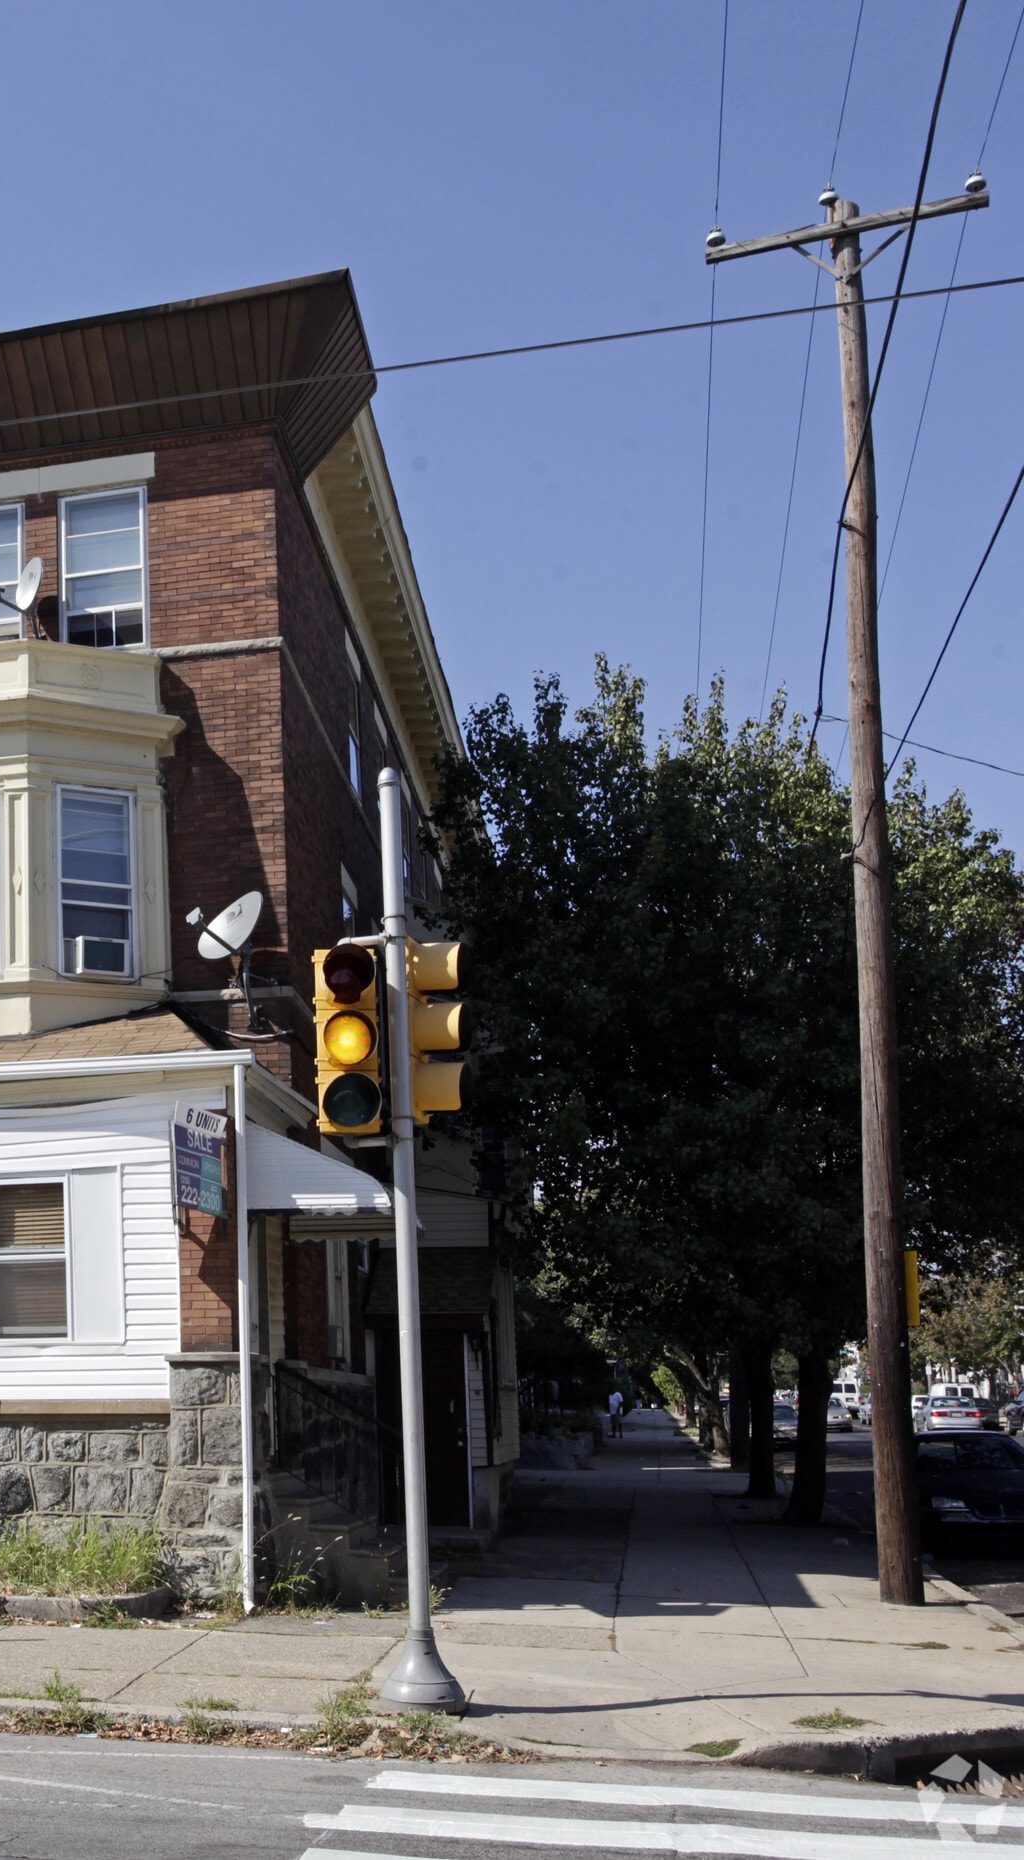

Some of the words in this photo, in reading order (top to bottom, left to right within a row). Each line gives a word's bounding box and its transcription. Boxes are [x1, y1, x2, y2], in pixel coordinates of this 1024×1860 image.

[186, 1108, 193, 1123] 6
[195, 1111, 220, 1133] UNITS
[187, 1129, 213, 1153] SALE
[181, 1185, 220, 1211] 222-2300
